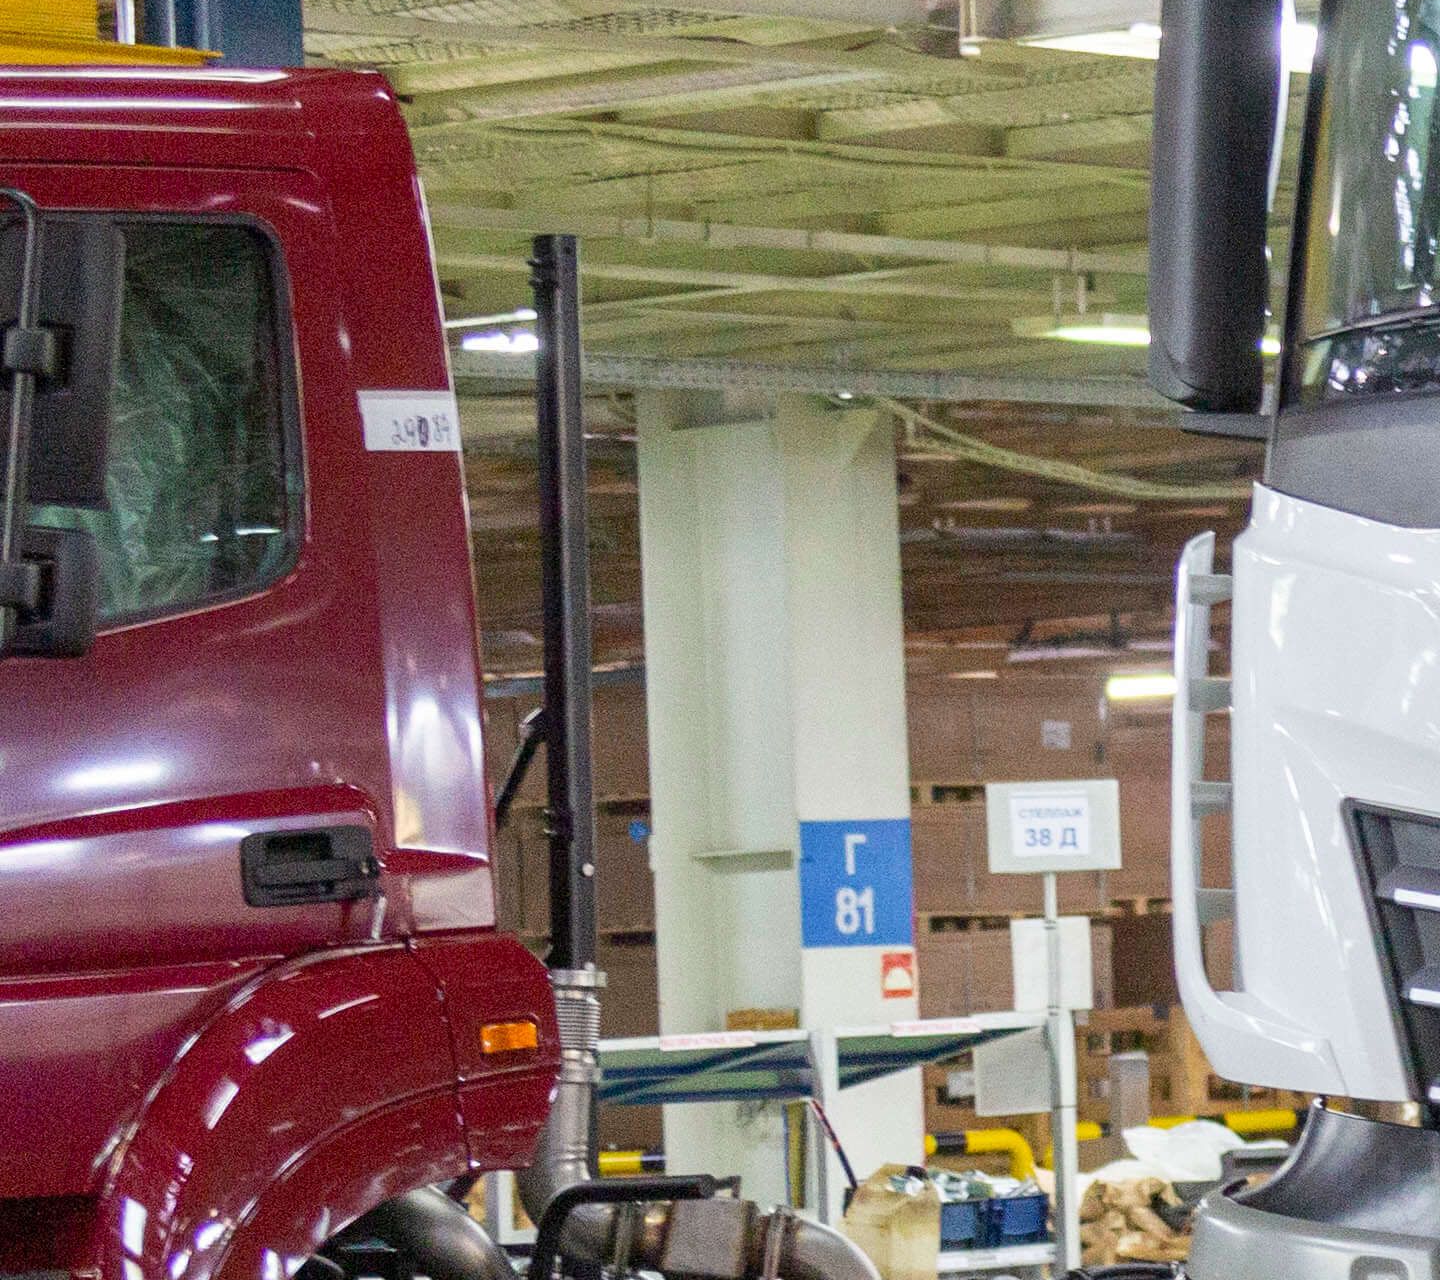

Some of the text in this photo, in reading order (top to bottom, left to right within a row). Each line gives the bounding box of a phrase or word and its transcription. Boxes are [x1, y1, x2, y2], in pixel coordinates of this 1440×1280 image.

[845, 834, 867, 875] Г
[1025, 827, 1078, 849] 38 Д
[836, 886, 875, 934] 81
